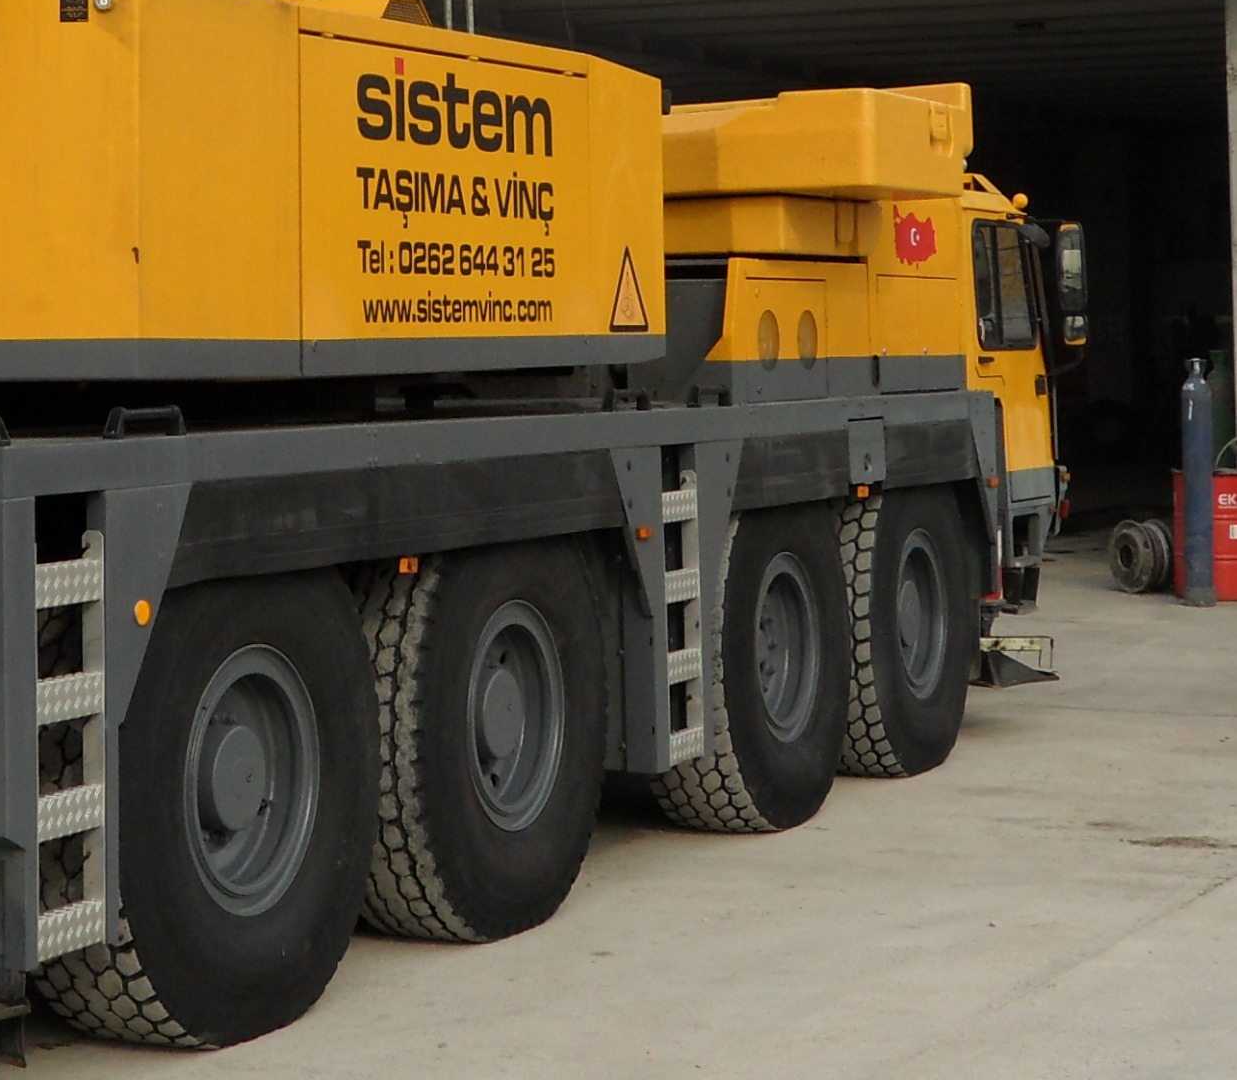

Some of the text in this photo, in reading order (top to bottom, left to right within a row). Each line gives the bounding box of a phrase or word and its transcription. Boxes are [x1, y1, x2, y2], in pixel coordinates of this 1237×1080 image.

[356, 57, 553, 157] sistem
[356, 166, 554, 237] TAŞIMA & VİNÇ
[398, 241, 455, 275] 0262
[459, 244, 499, 276] 644
[503, 246, 525, 277] 31
[531, 247, 555, 278] 25
[363, 290, 553, 323] www.sistemvinc.com
